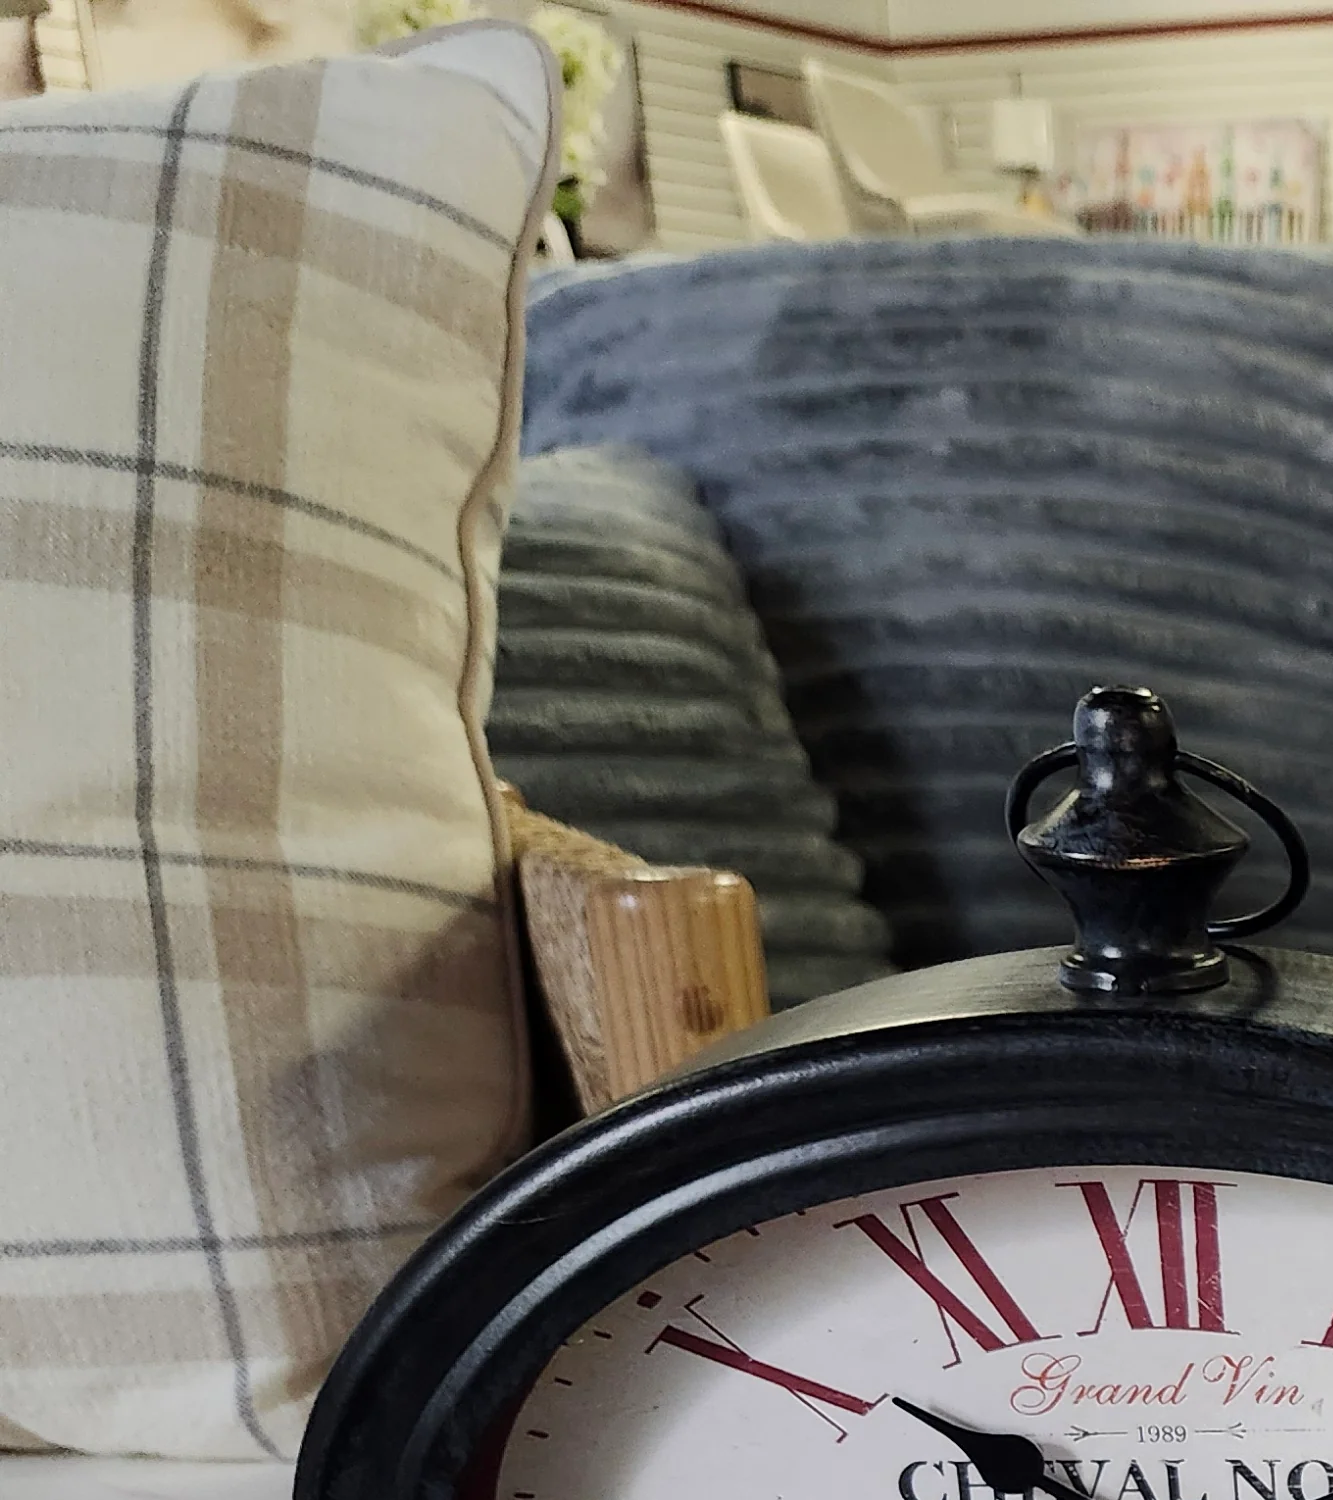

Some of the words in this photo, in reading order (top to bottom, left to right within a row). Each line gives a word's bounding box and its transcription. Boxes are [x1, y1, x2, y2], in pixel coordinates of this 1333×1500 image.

[833, 1192, 1062, 1370] XI
[1055, 1179, 1240, 1337] XII
[644, 1294, 889, 1445] X
[1009, 1352, 1196, 1417] Grand
[1202, 1354, 1305, 1408] Vin
[1136, 1424, 1188, 1444] 1989
